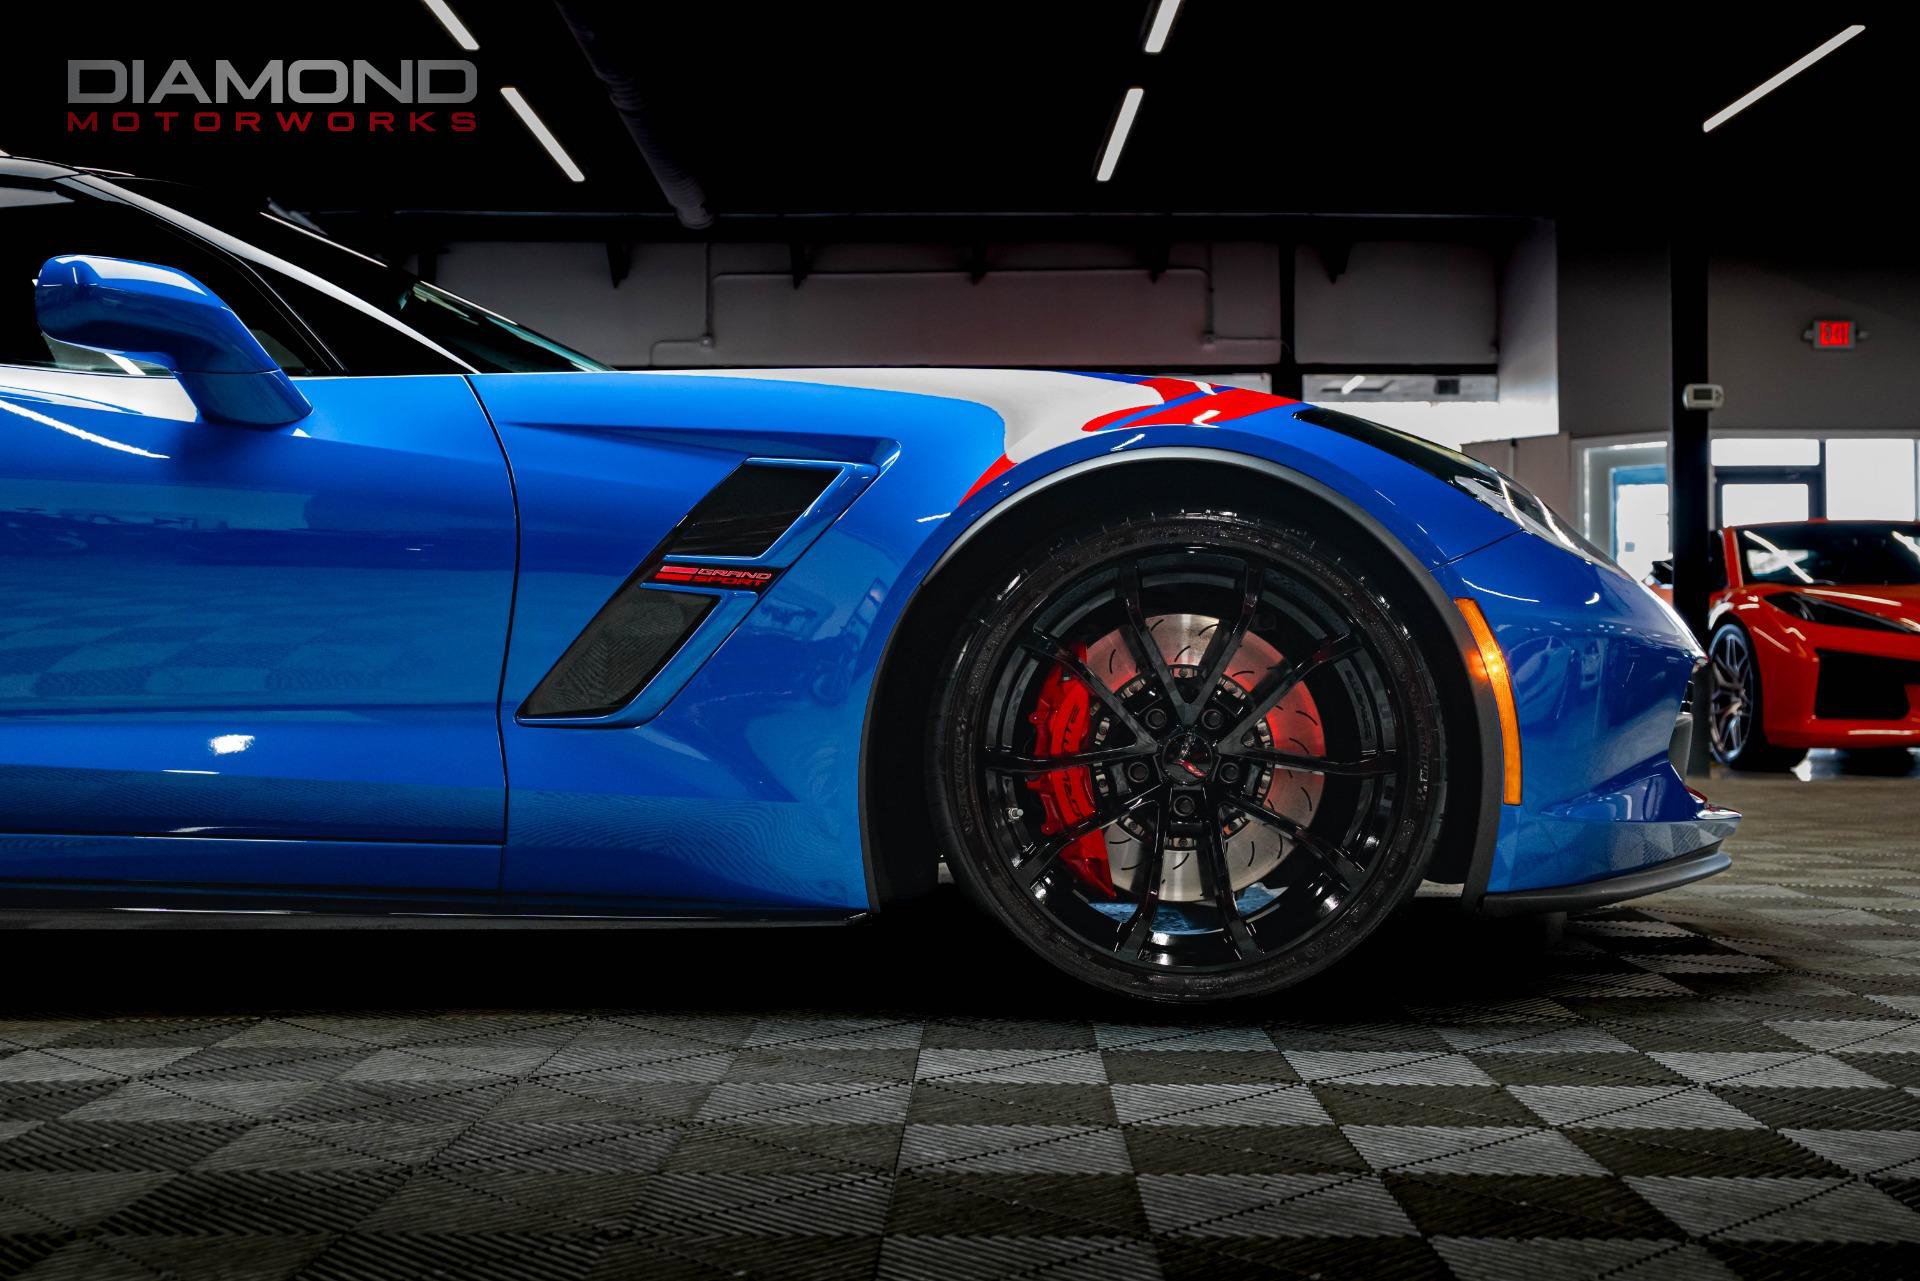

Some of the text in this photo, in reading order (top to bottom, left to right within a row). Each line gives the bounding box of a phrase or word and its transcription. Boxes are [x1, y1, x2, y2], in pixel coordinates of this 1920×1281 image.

[1819, 321, 1849, 346] EXIT
[697, 568, 772, 580] GRAND
[693, 575, 769, 587] SPORT
